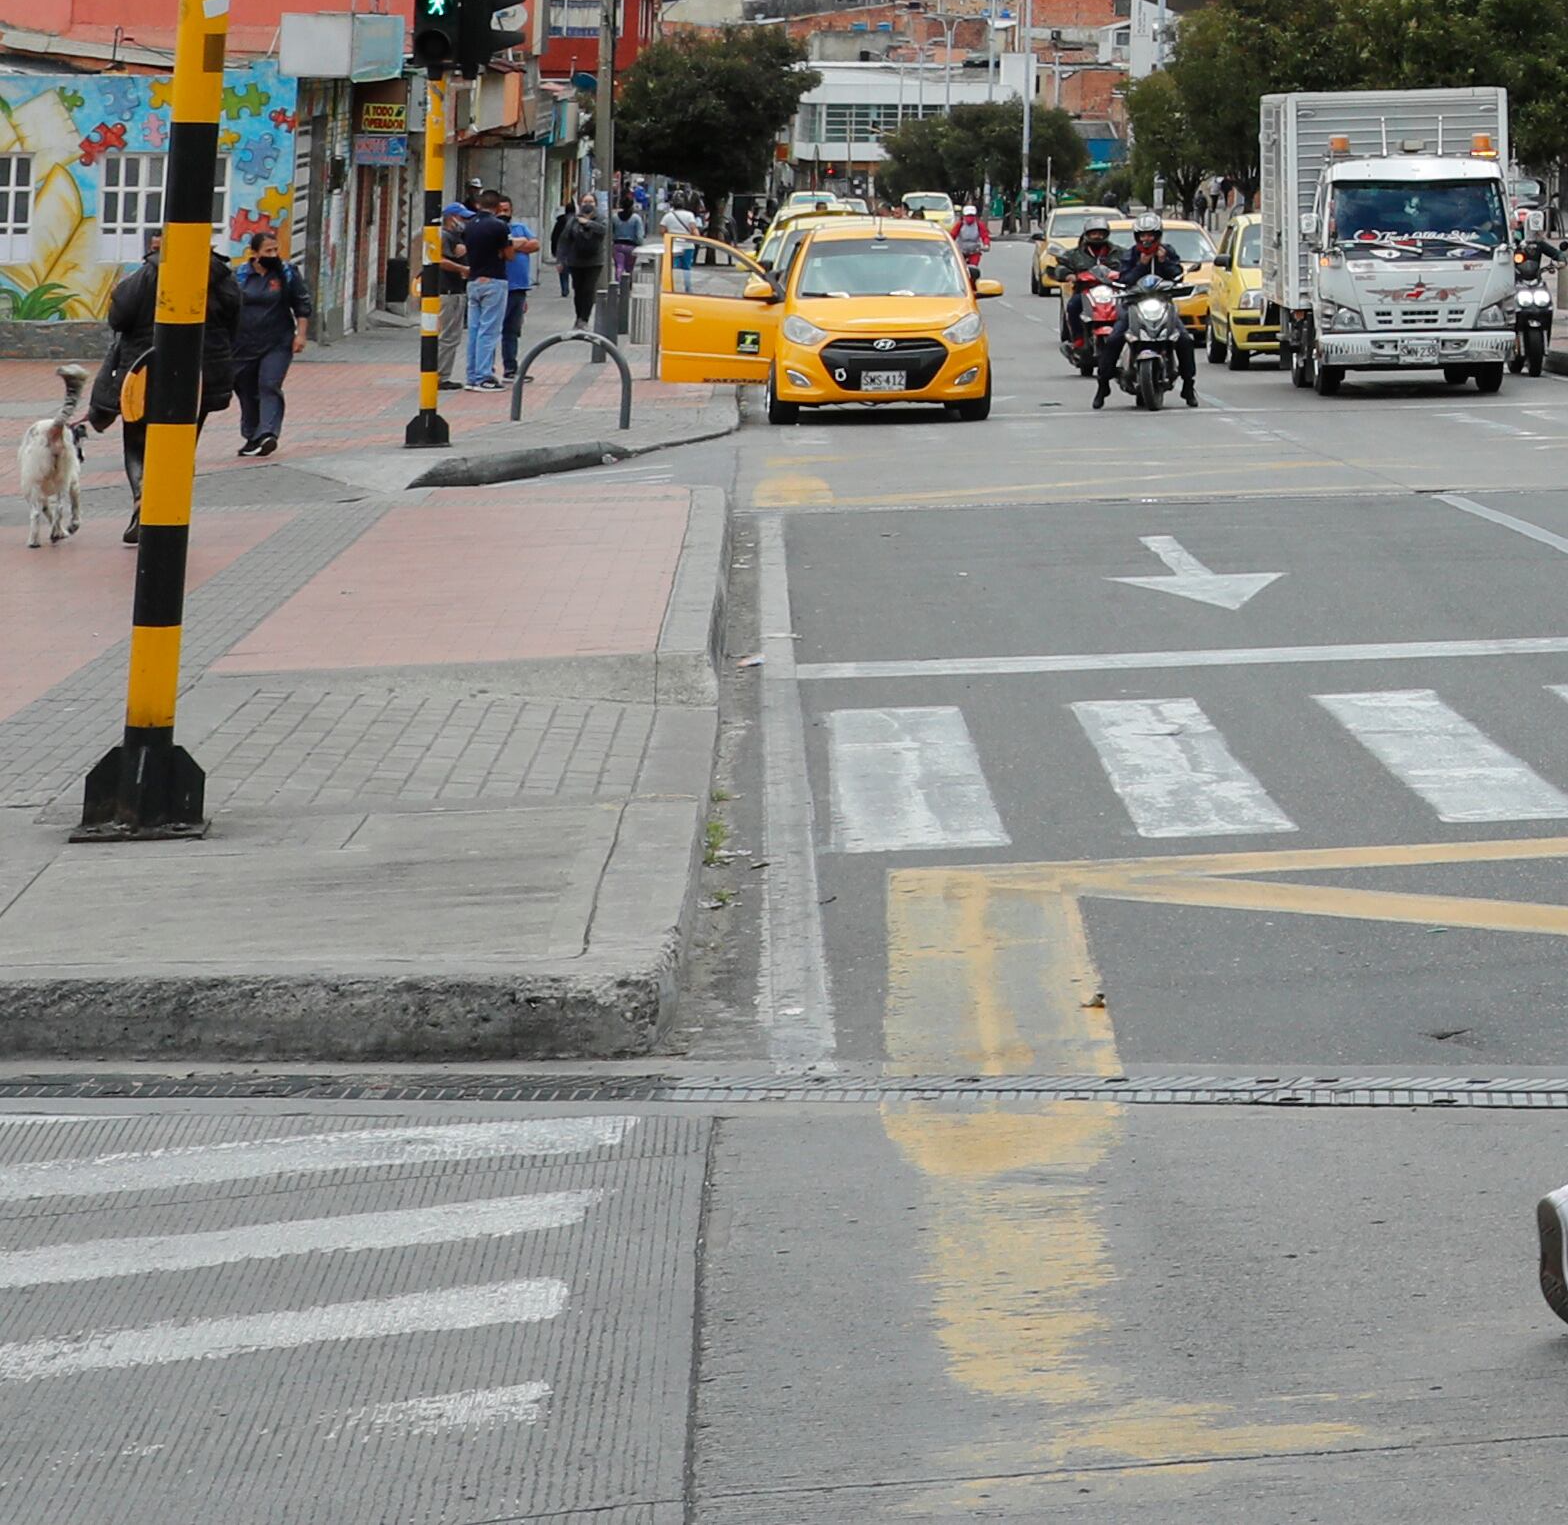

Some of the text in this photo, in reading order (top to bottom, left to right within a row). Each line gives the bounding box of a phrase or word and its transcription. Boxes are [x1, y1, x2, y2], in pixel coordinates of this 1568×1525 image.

[364, 105, 394, 117] A TODO
[363, 117, 405, 129] OPERADOR
